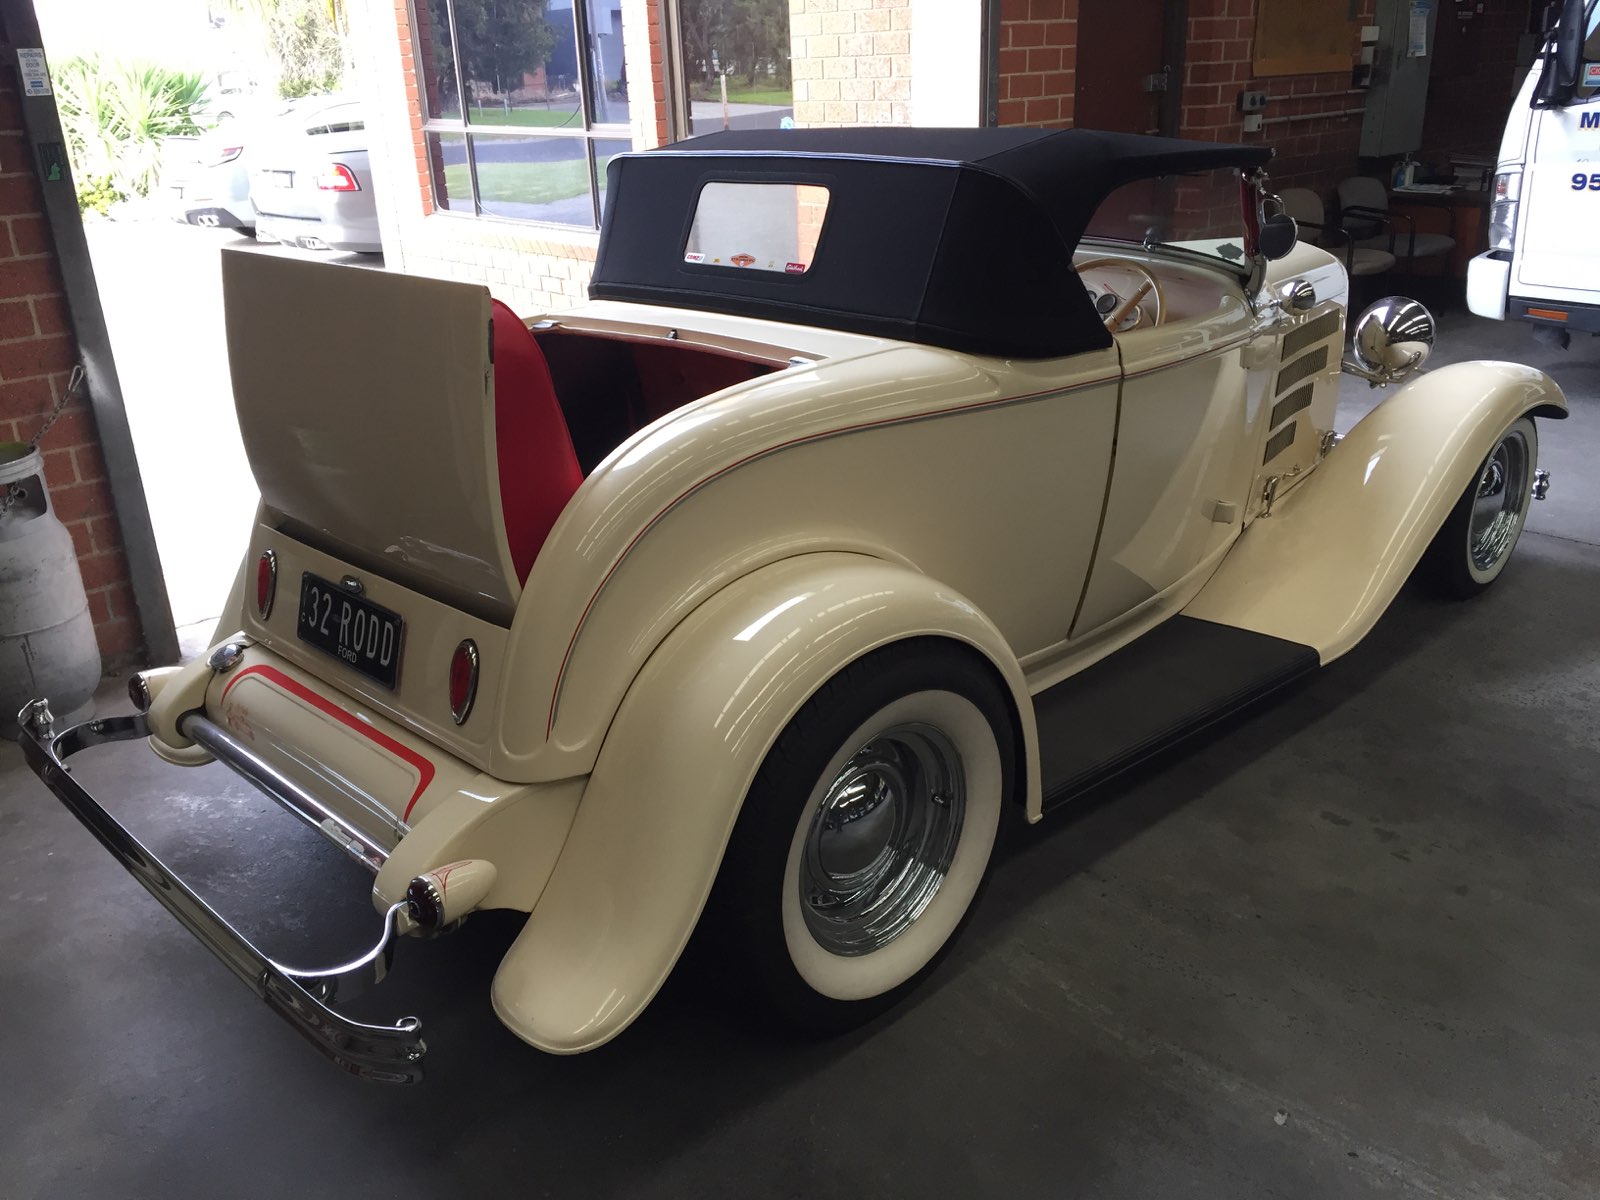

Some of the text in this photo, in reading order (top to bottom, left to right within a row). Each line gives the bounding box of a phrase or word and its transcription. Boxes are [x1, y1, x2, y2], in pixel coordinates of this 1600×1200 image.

[308, 586, 394, 666] 32 RODD
[337, 645, 357, 663] FORD
